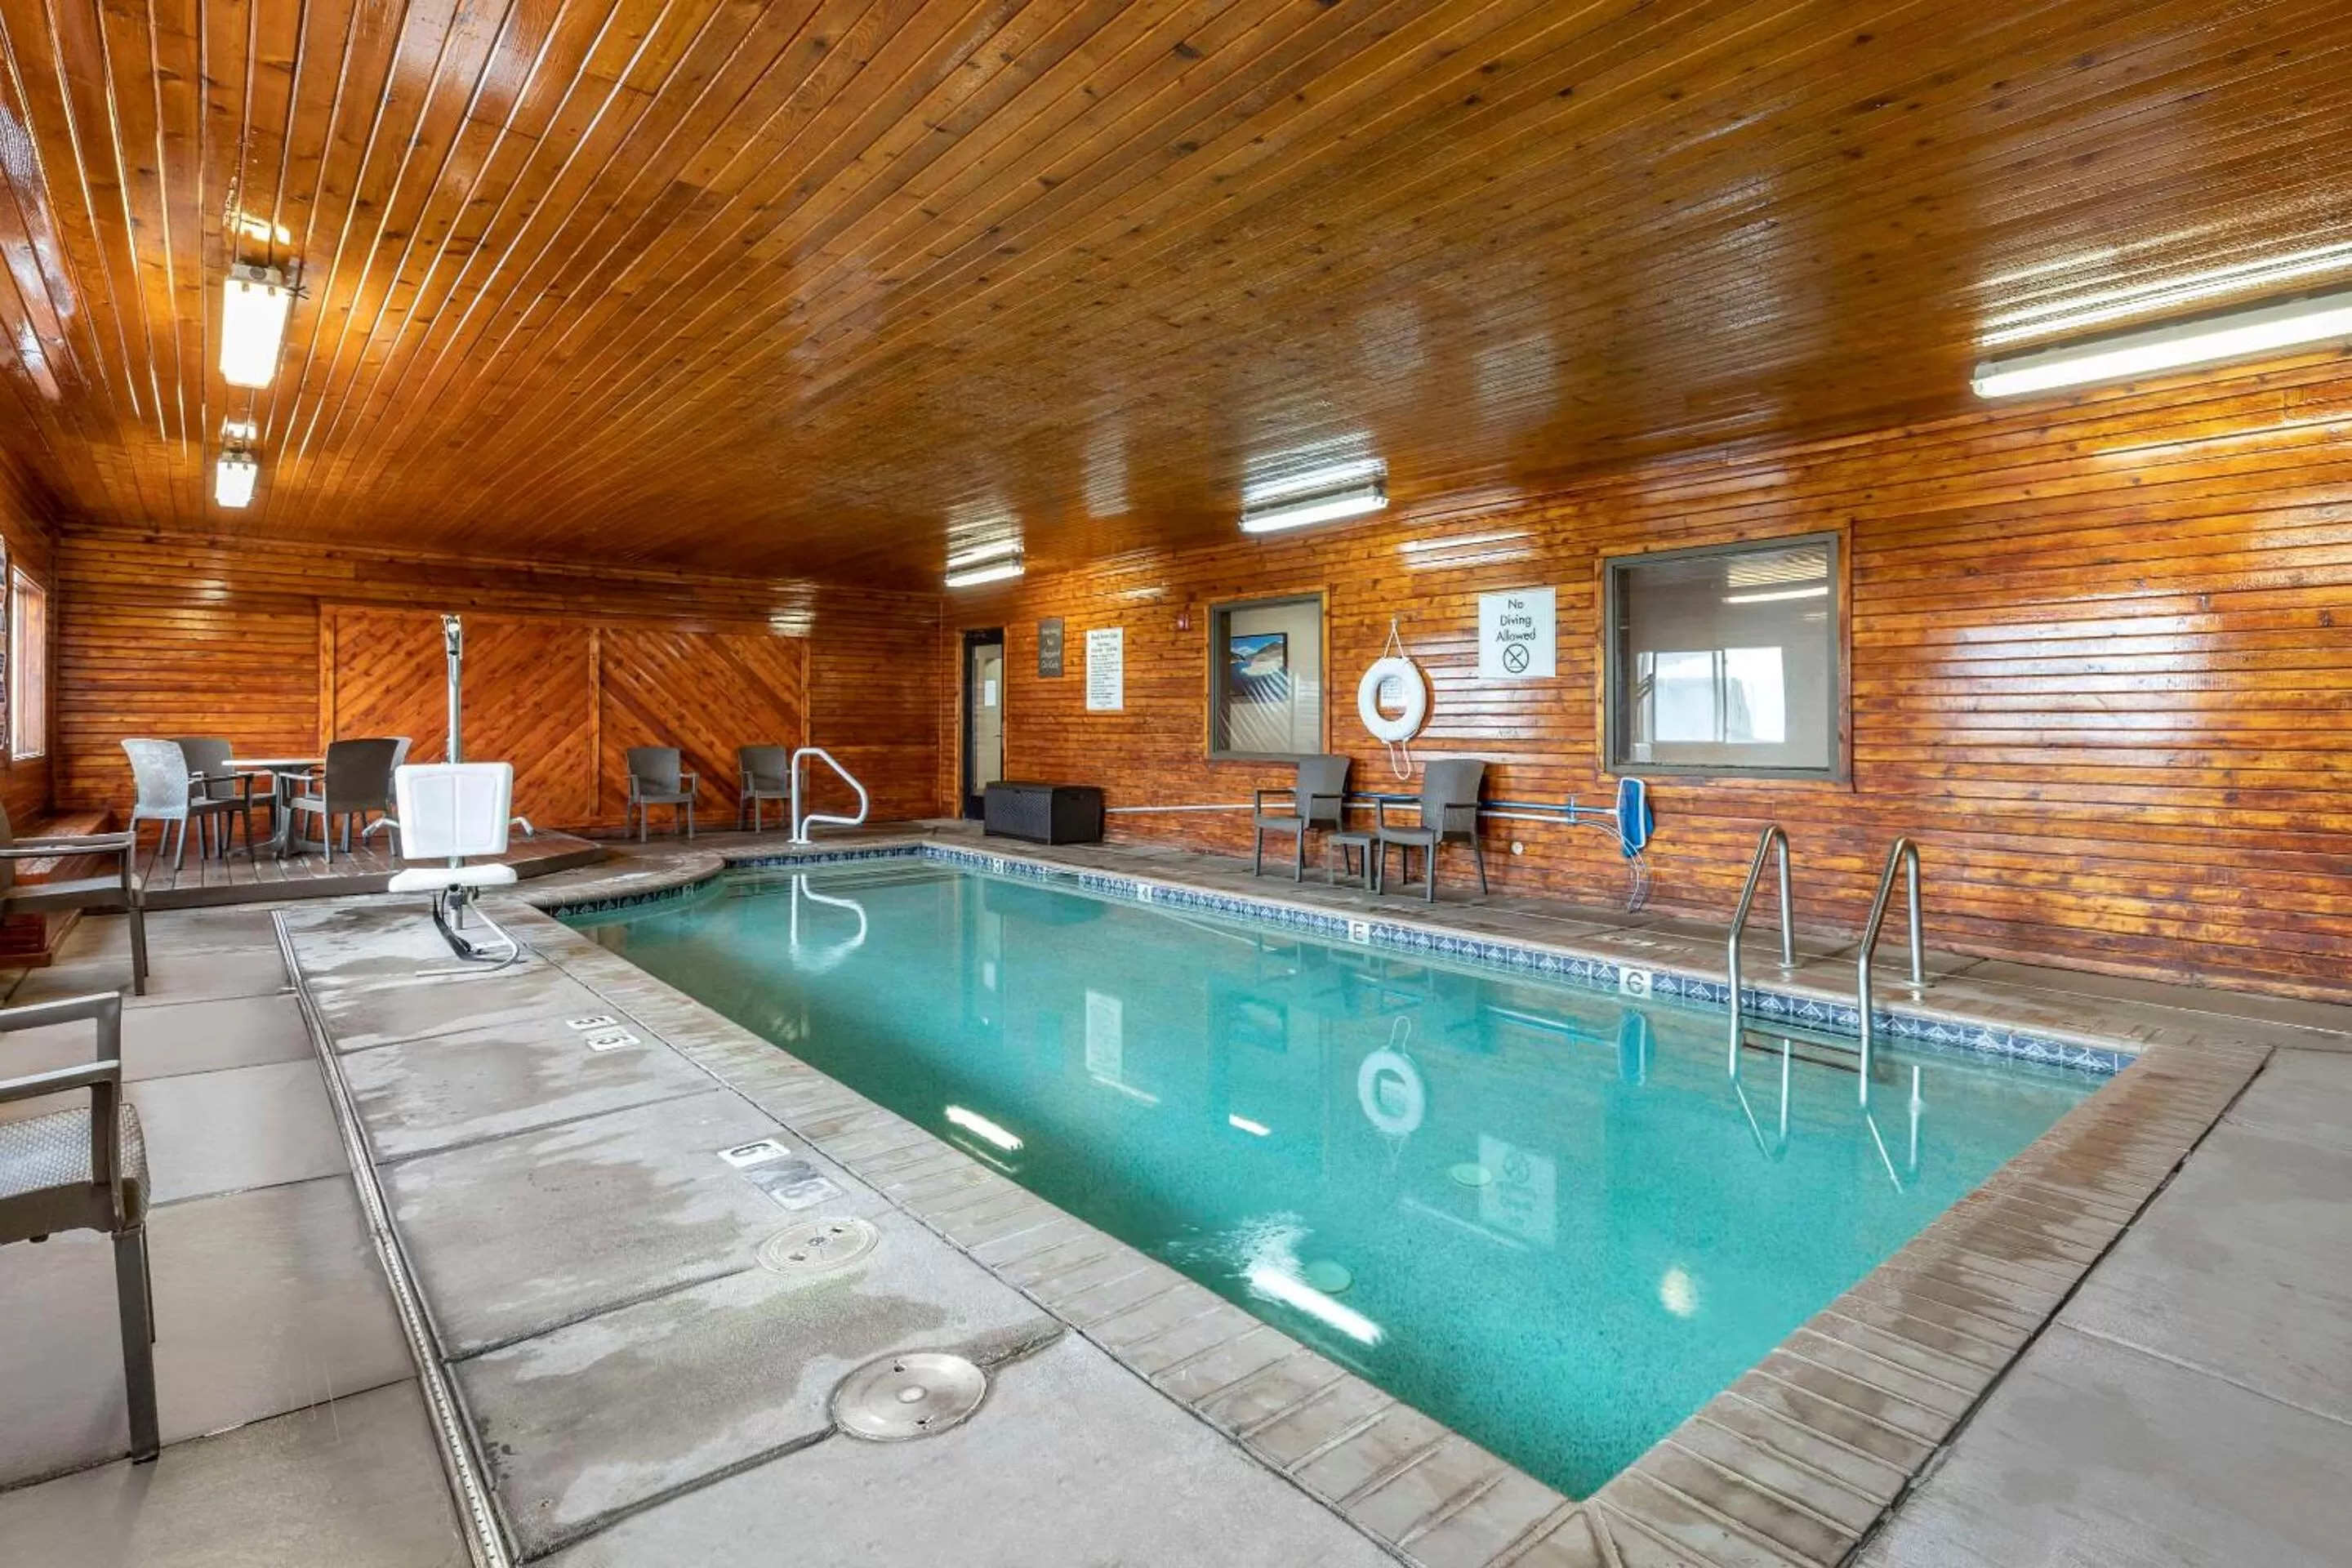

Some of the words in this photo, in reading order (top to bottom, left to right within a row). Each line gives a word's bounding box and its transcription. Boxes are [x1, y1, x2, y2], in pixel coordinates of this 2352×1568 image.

[1508, 599, 1525, 610] No
[1500, 613, 1532, 628] Diving
[1495, 628, 1536, 642] Allowed
